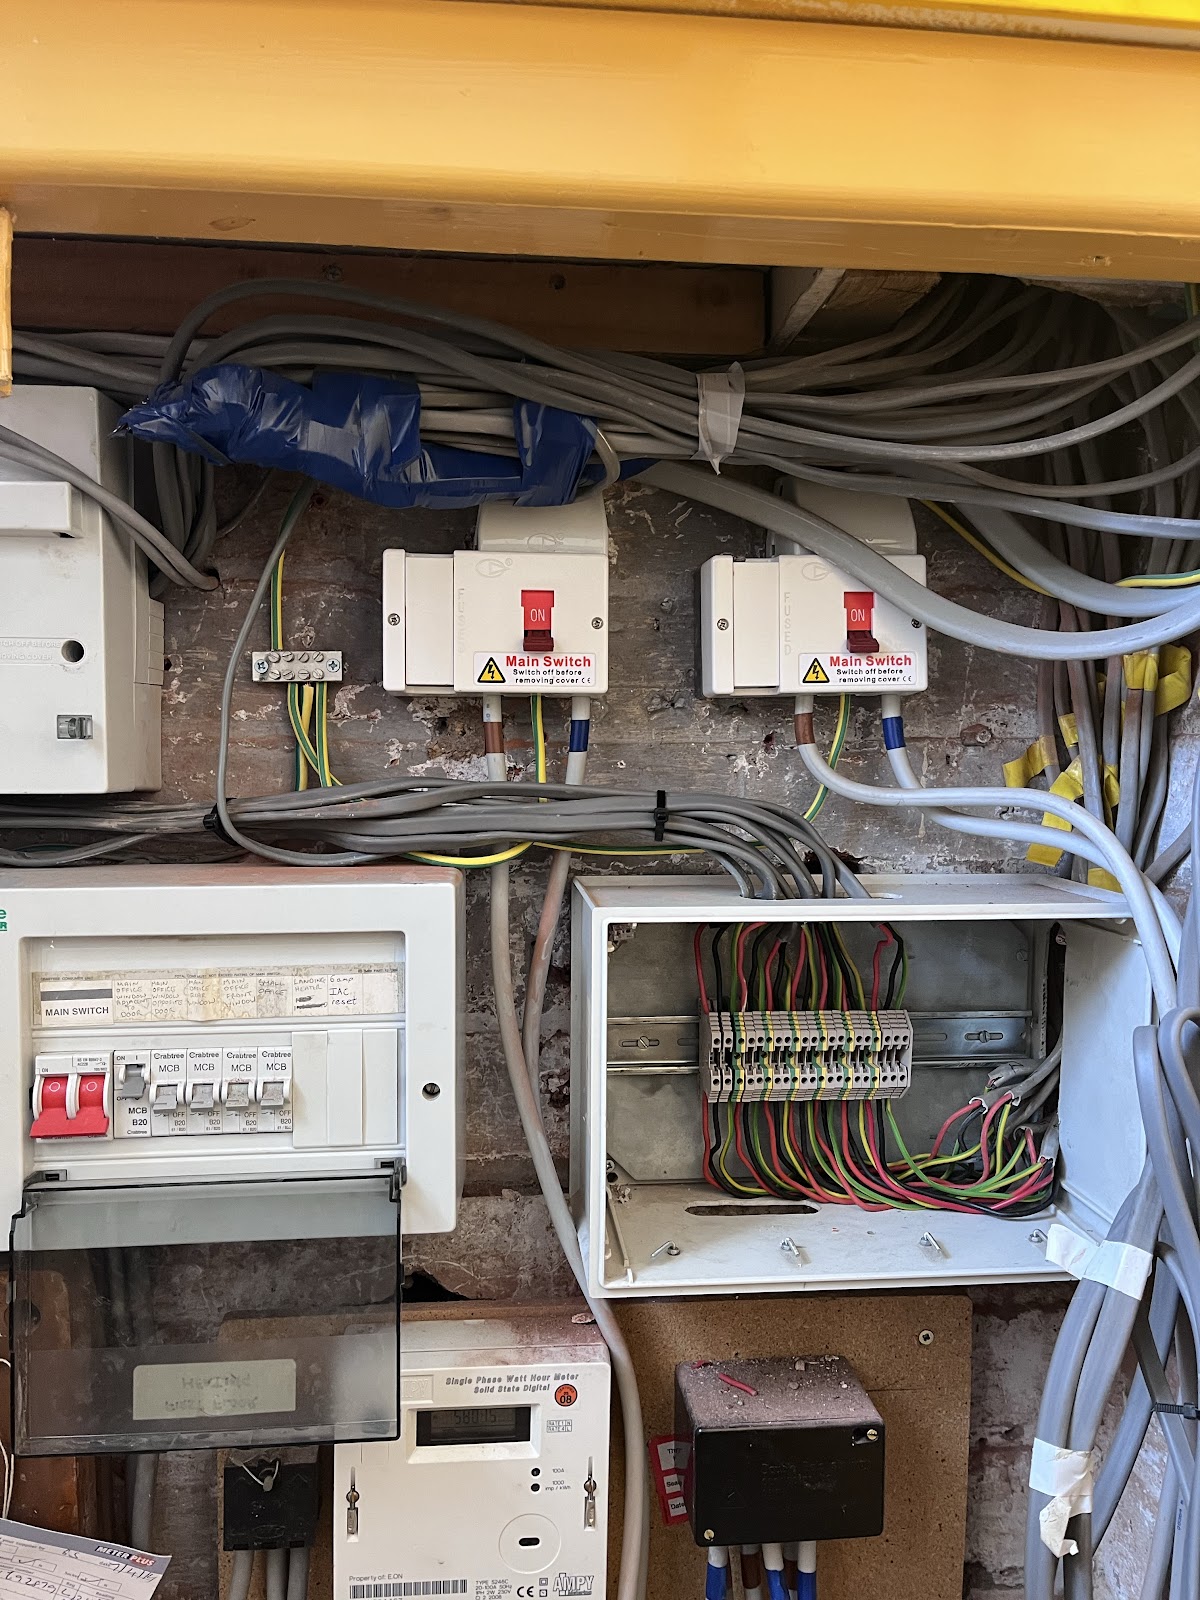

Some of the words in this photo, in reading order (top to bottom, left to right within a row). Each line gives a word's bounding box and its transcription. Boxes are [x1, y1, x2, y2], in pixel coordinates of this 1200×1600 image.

[530, 609, 546, 622] ON
[851, 609, 864, 622] ON
[506, 655, 539, 667] Main
[544, 655, 591, 667] Switch
[830, 656, 862, 667] Main
[866, 655, 911, 666] Switch
[332, 997, 357, 1005] reset
[45, 1008, 69, 1016] MAIN
[72, 1007, 109, 1015] SWITCH
[231, 1064, 251, 1072] MCB
[446, 1378, 472, 1386] Single
[476, 1376, 502, 1384] Phase
[530, 1374, 550, 1382] Hour
[96, 1546, 130, 1559] METER
[129, 1554, 154, 1566] PLUS
[553, 1573, 594, 1592] AMPY
